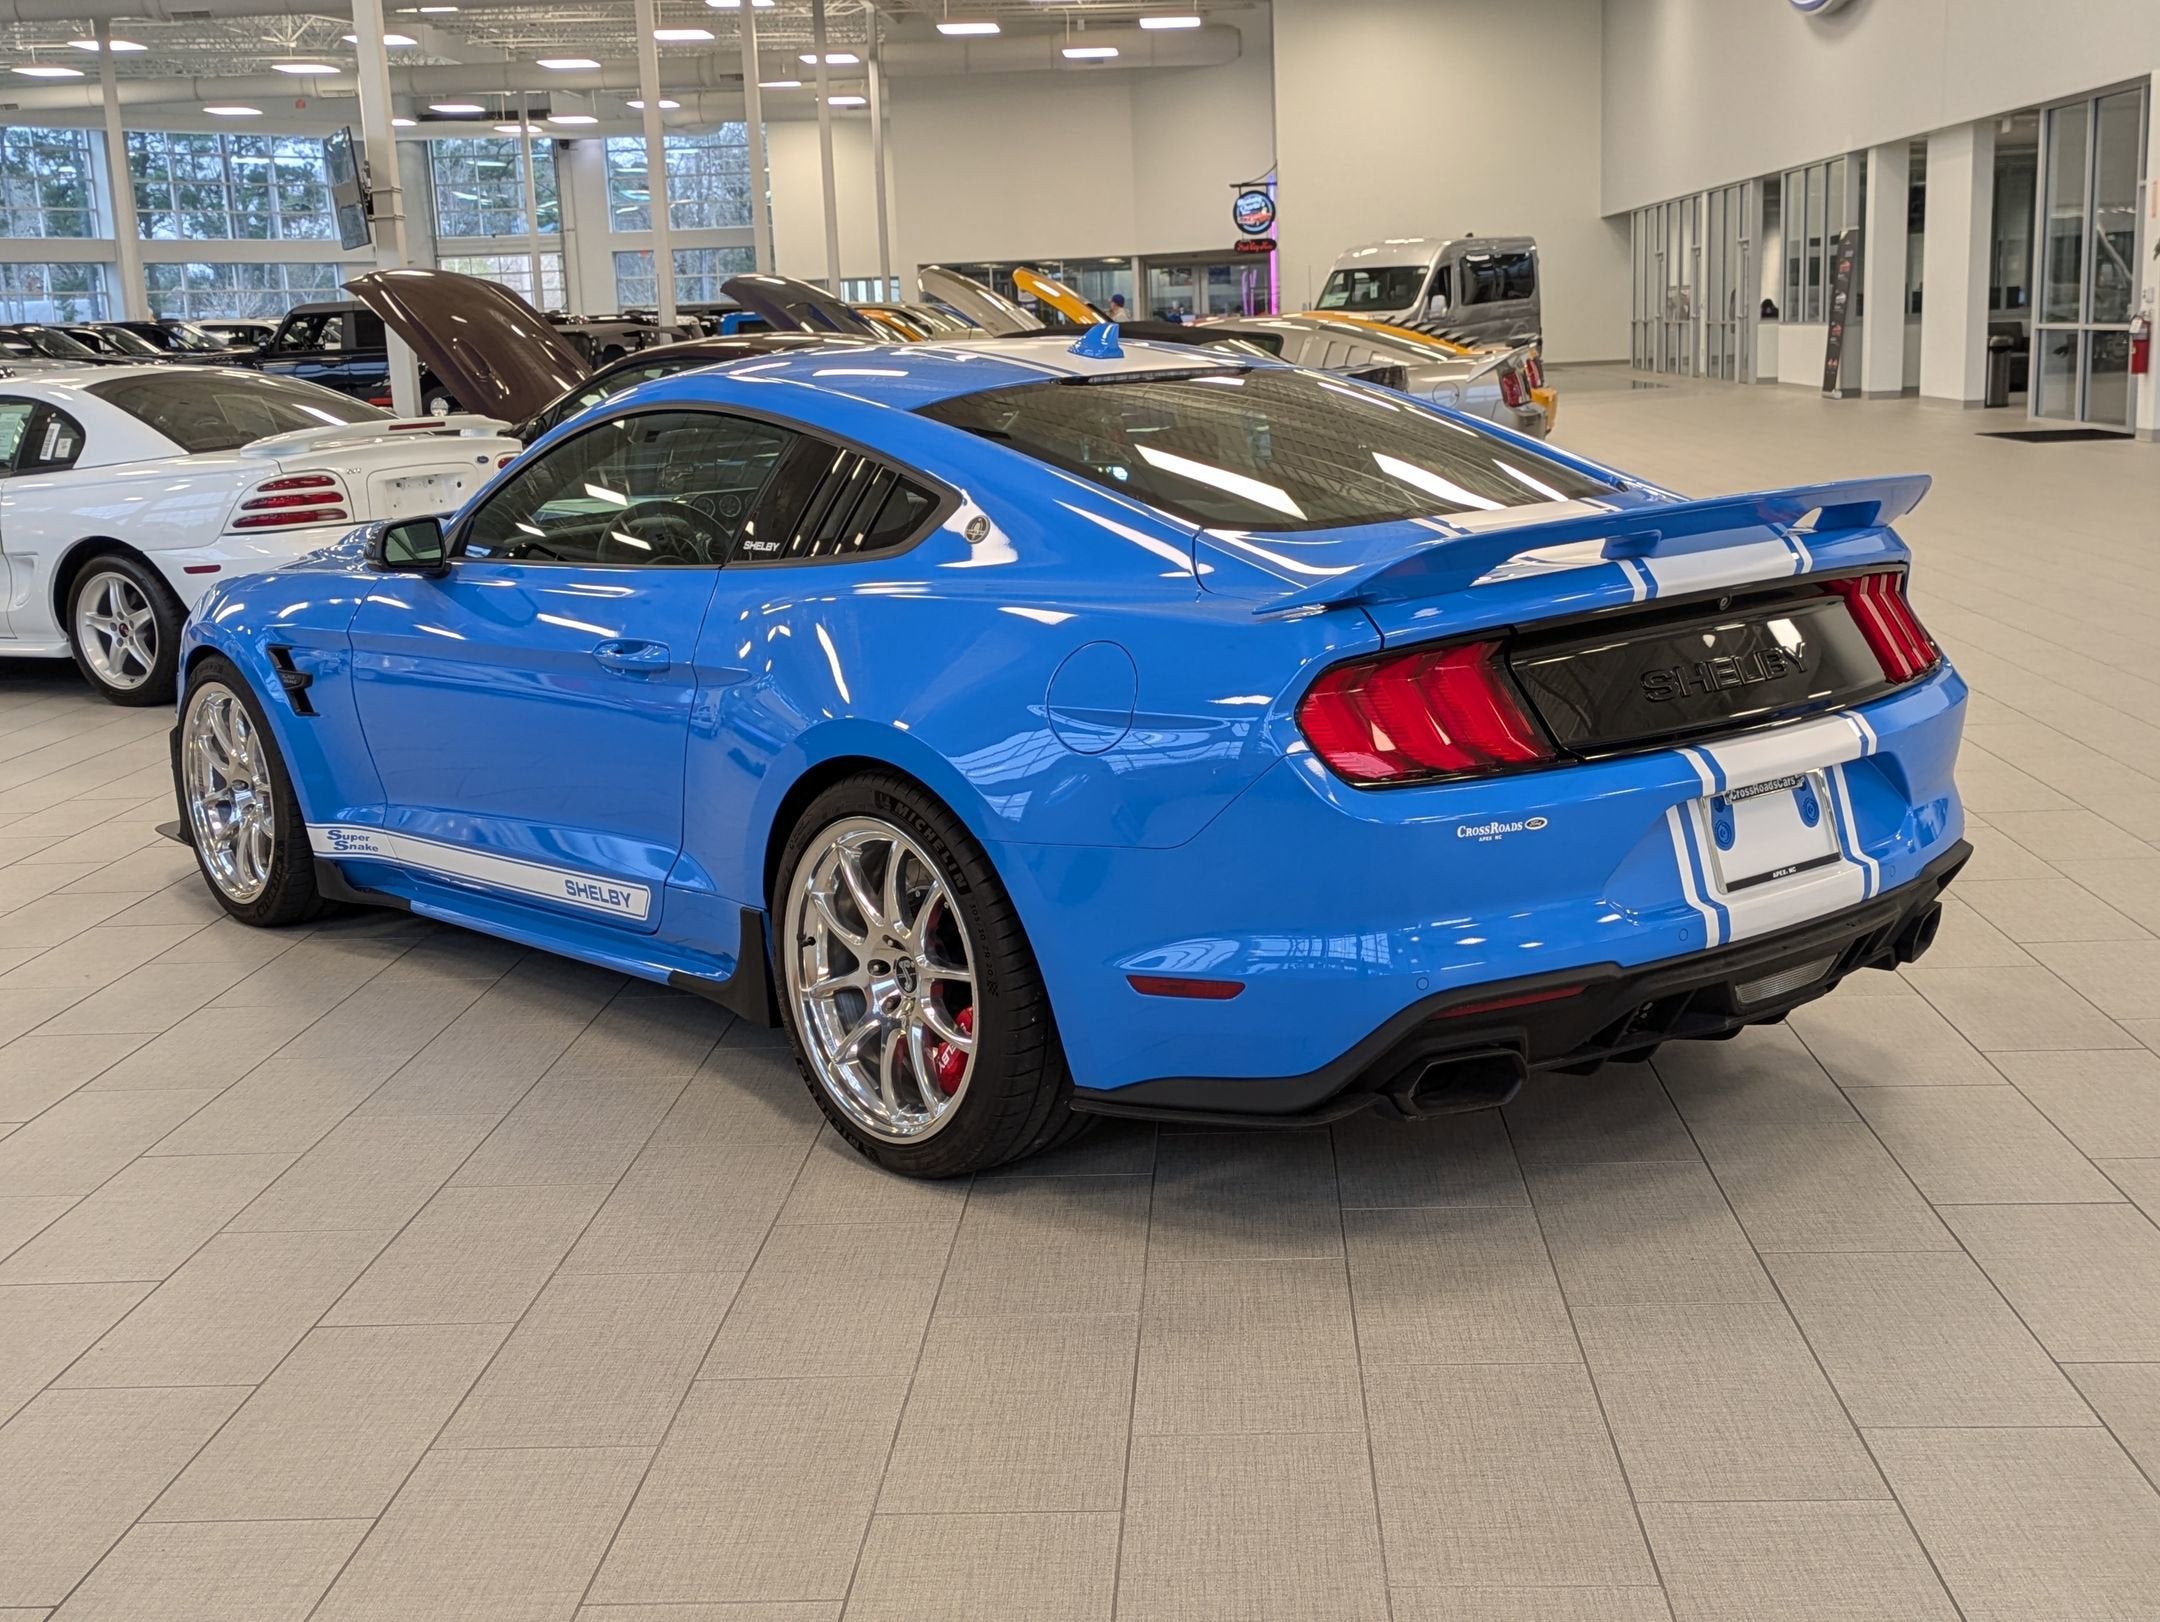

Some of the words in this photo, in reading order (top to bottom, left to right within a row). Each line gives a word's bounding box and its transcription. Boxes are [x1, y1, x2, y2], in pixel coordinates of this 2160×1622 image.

[743, 541, 780, 551] SHELBY
[1641, 642, 1806, 702] SHELBY
[327, 829, 370, 842] Super
[333, 840, 379, 852] Snake
[896, 802, 969, 890] MICHELIN
[565, 879, 631, 908] SHELBY
